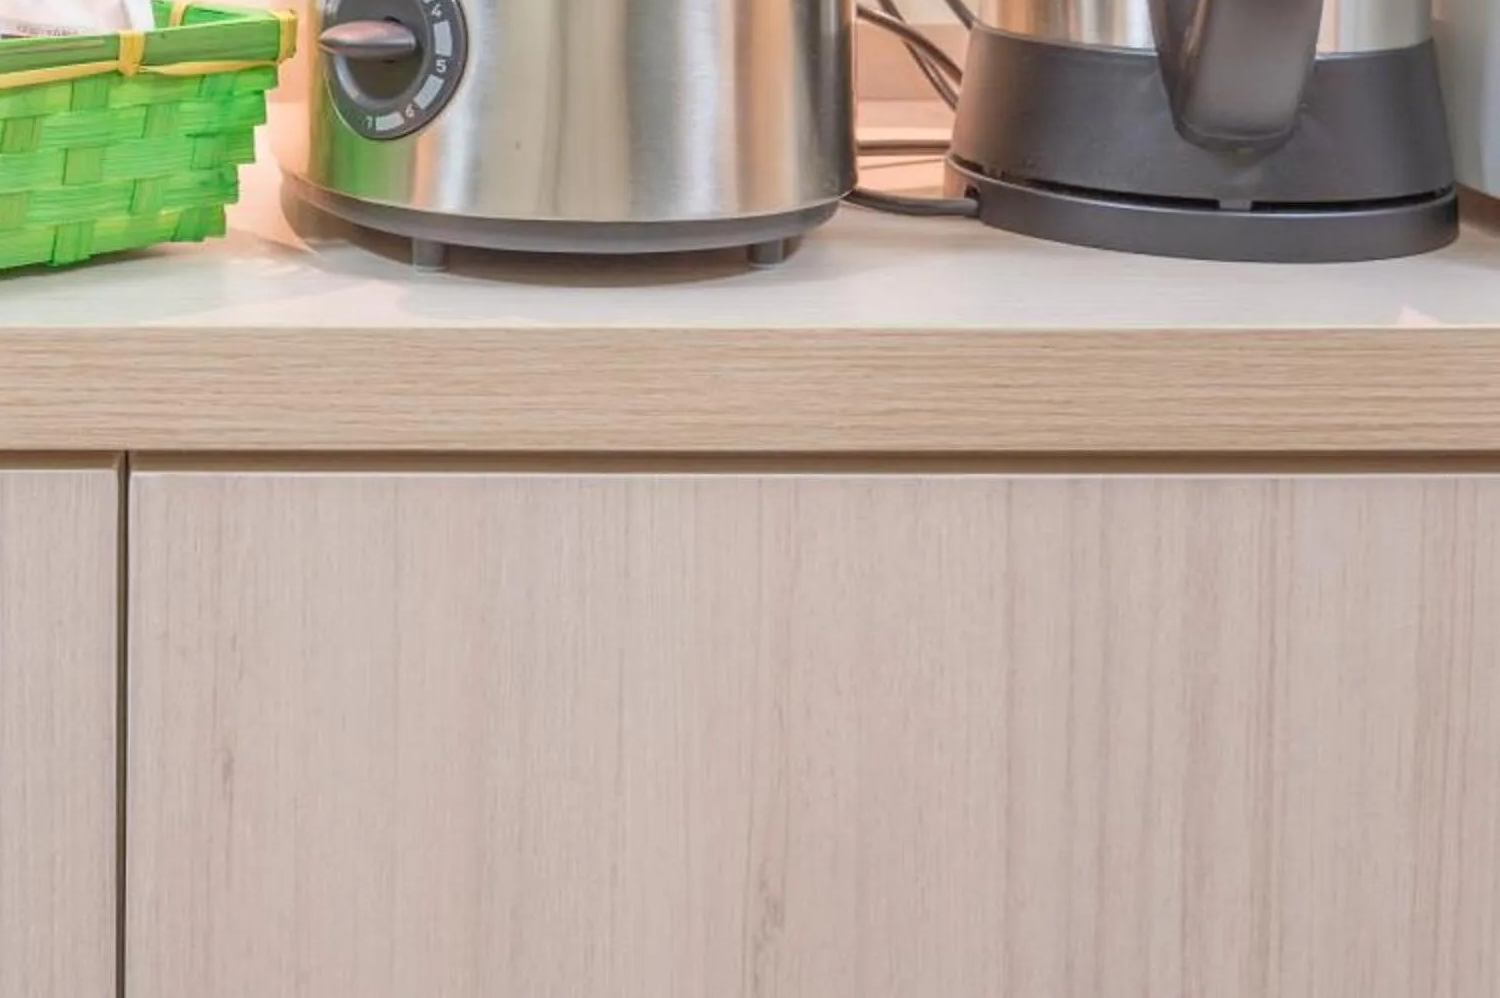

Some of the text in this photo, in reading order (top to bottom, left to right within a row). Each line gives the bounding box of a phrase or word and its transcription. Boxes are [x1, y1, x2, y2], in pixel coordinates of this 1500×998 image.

[431, 3, 442, 17] 4
[435, 59, 447, 73] 5
[405, 103, 415, 118] 6
